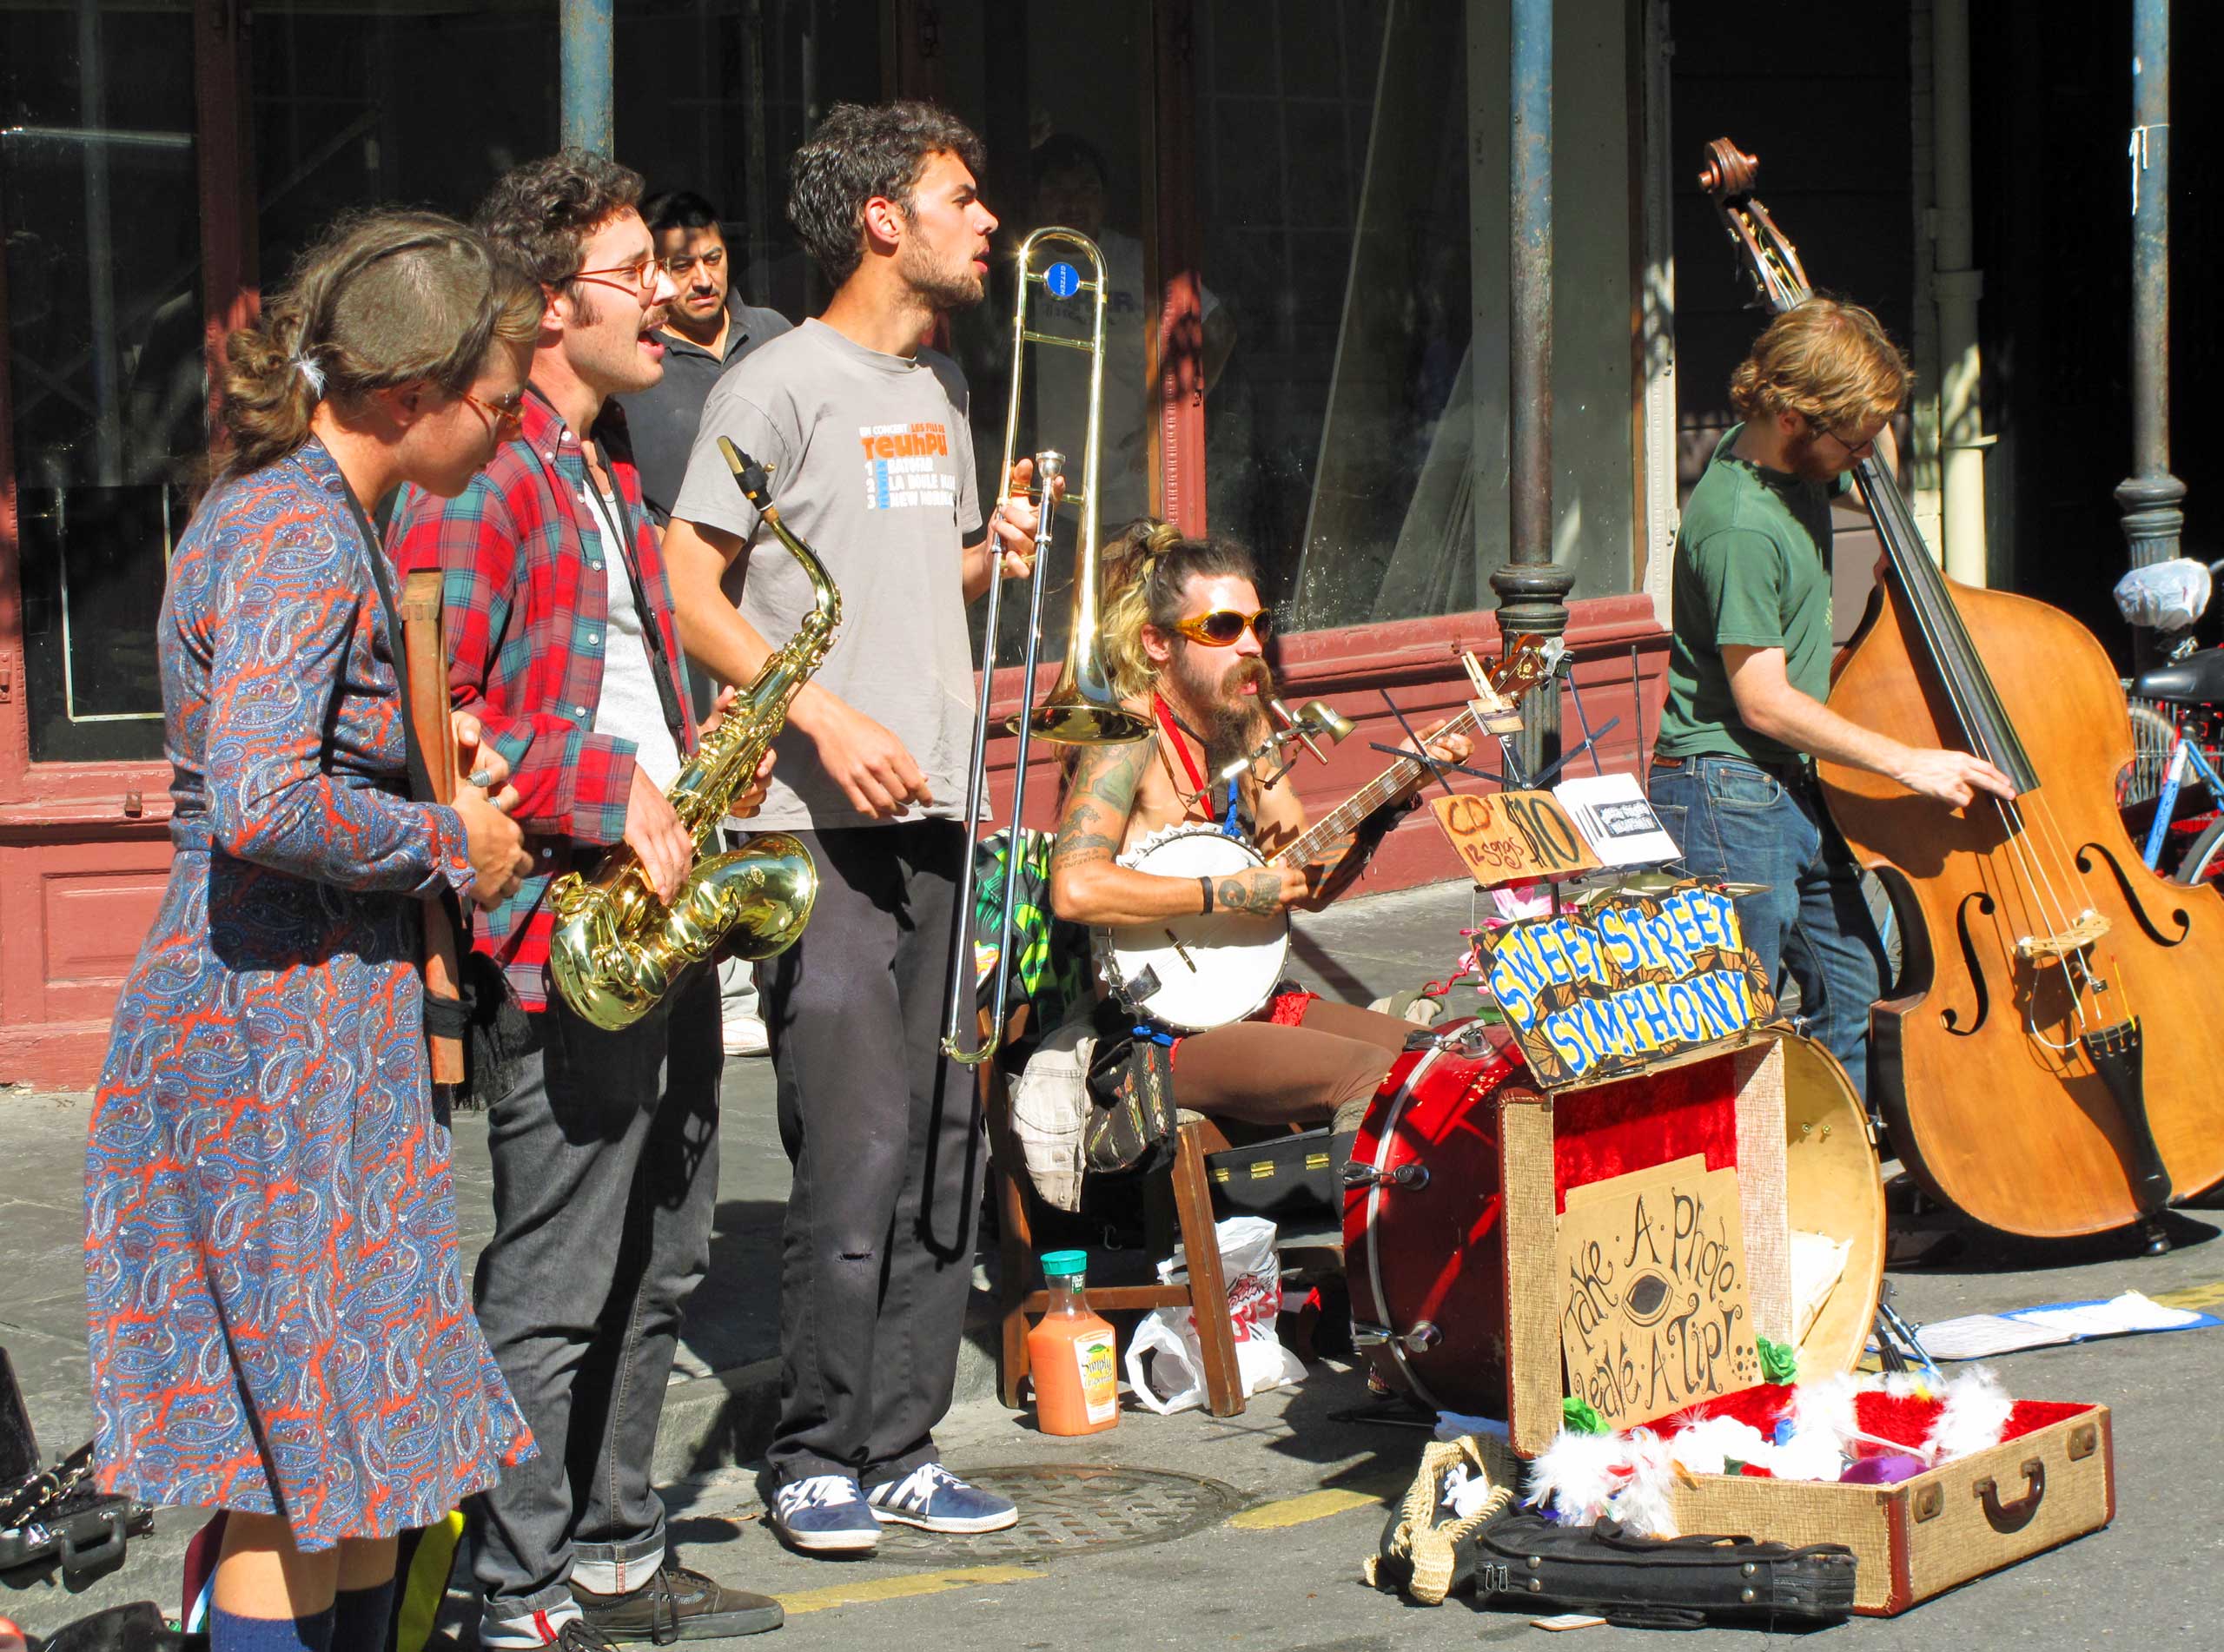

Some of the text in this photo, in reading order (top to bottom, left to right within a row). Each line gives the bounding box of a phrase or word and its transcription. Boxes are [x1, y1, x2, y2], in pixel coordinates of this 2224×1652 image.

[1464, 843, 1485, 867] 12
[1499, 794, 1580, 869] $10
[1490, 889, 1737, 1032] SWEET STREET
[1546, 968, 1751, 1076] SYMPHONY
[1565, 1239, 1618, 1355] Take
[1624, 1193, 1662, 1268] A
[1081, 1353, 1112, 1377] Simply
[1645, 1331, 1679, 1411] A
